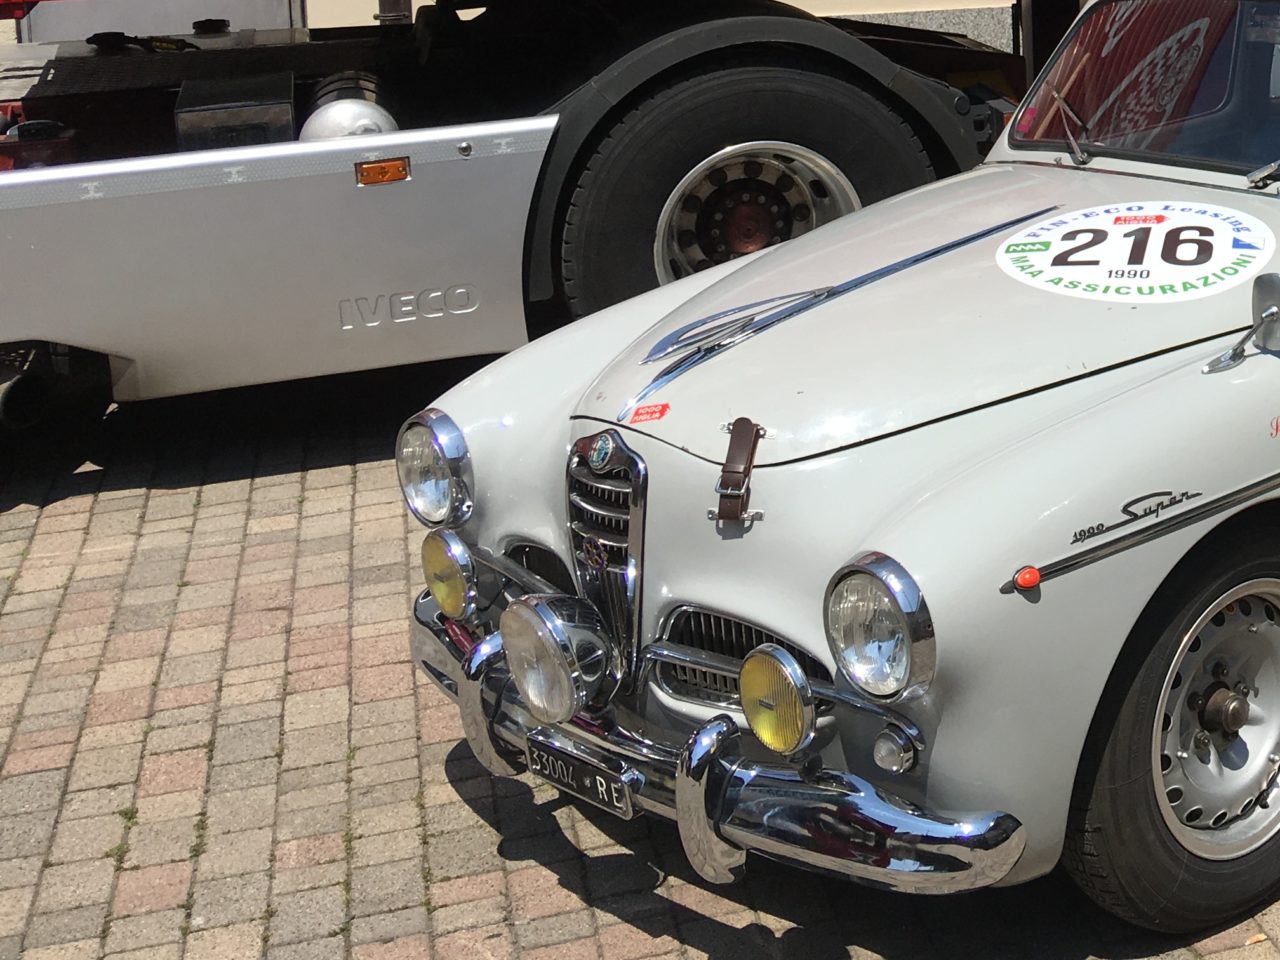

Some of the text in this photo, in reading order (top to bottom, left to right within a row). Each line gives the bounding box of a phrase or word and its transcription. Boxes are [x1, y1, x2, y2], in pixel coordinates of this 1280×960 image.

[1024, 204, 1252, 238] FIN-ECO Leasing
[1050, 225, 1214, 267] 216
[1010, 253, 1257, 296] MAA ASSICURAZIONI
[1106, 269, 1151, 280] 1990
[338, 283, 480, 330] IVECO
[1070, 490, 1203, 544] 1900 Super
[530, 747, 624, 808] 33004 RE
